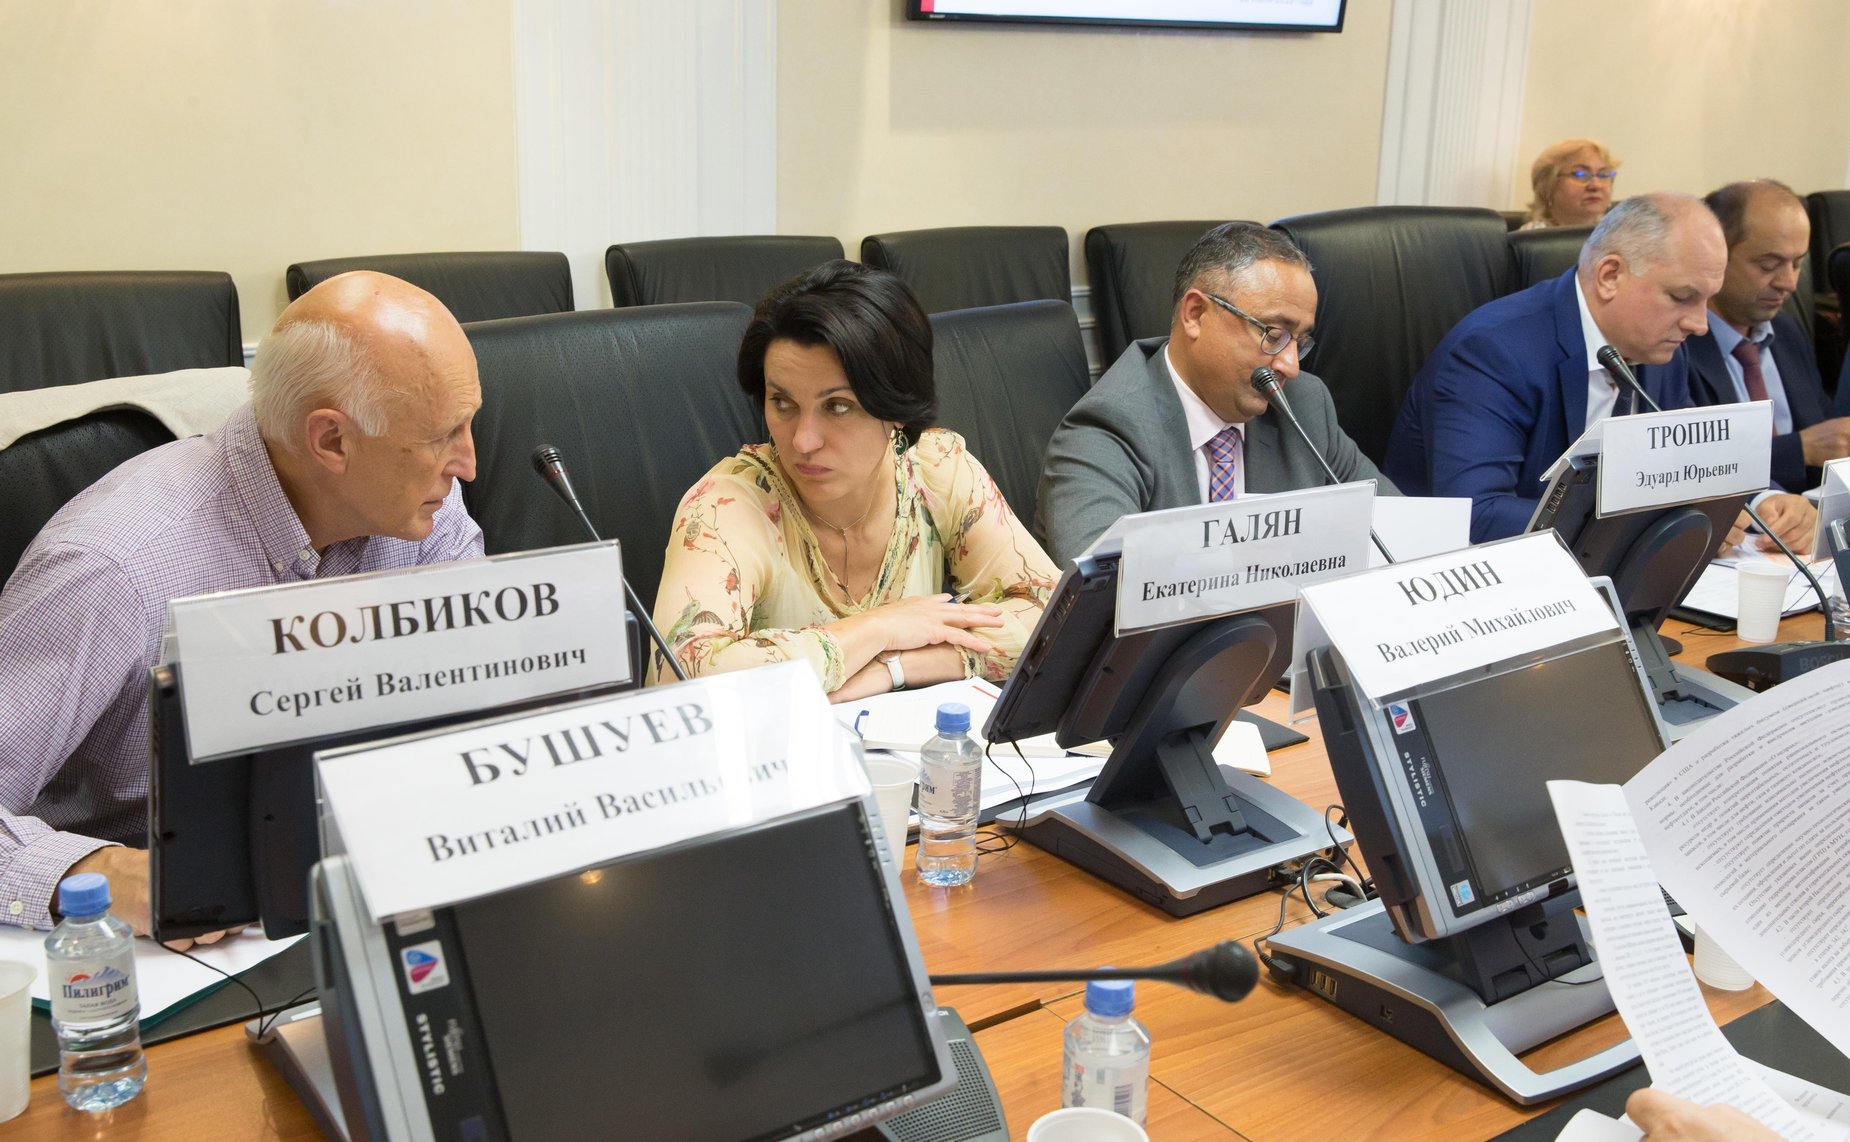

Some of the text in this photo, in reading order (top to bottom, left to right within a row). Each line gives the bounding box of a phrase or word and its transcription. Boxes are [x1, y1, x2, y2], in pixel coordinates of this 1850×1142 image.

[1647, 418, 1730, 450] ТРОПИН
[1636, 463, 1738, 489] Эдуард Юрьевич
[1200, 507, 1302, 549] ГАЛЯН
[1142, 553, 1346, 602] Екатерина Николаевна
[1397, 560, 1503, 607] ЮДИН
[267, 581, 561, 656] КОЛБИКОВ
[1377, 598, 1577, 664] Валерий Михайлович
[249, 646, 588, 717] Сергей Валентинович
[459, 701, 714, 788] БУШУЕВ
[1404, 751, 1427, 807] STYLISTIC
[426, 758, 789, 864] Виталий Васильич
[63, 978, 129, 998] Пилигрим
[416, 1013, 445, 1095] STYLISTIC
